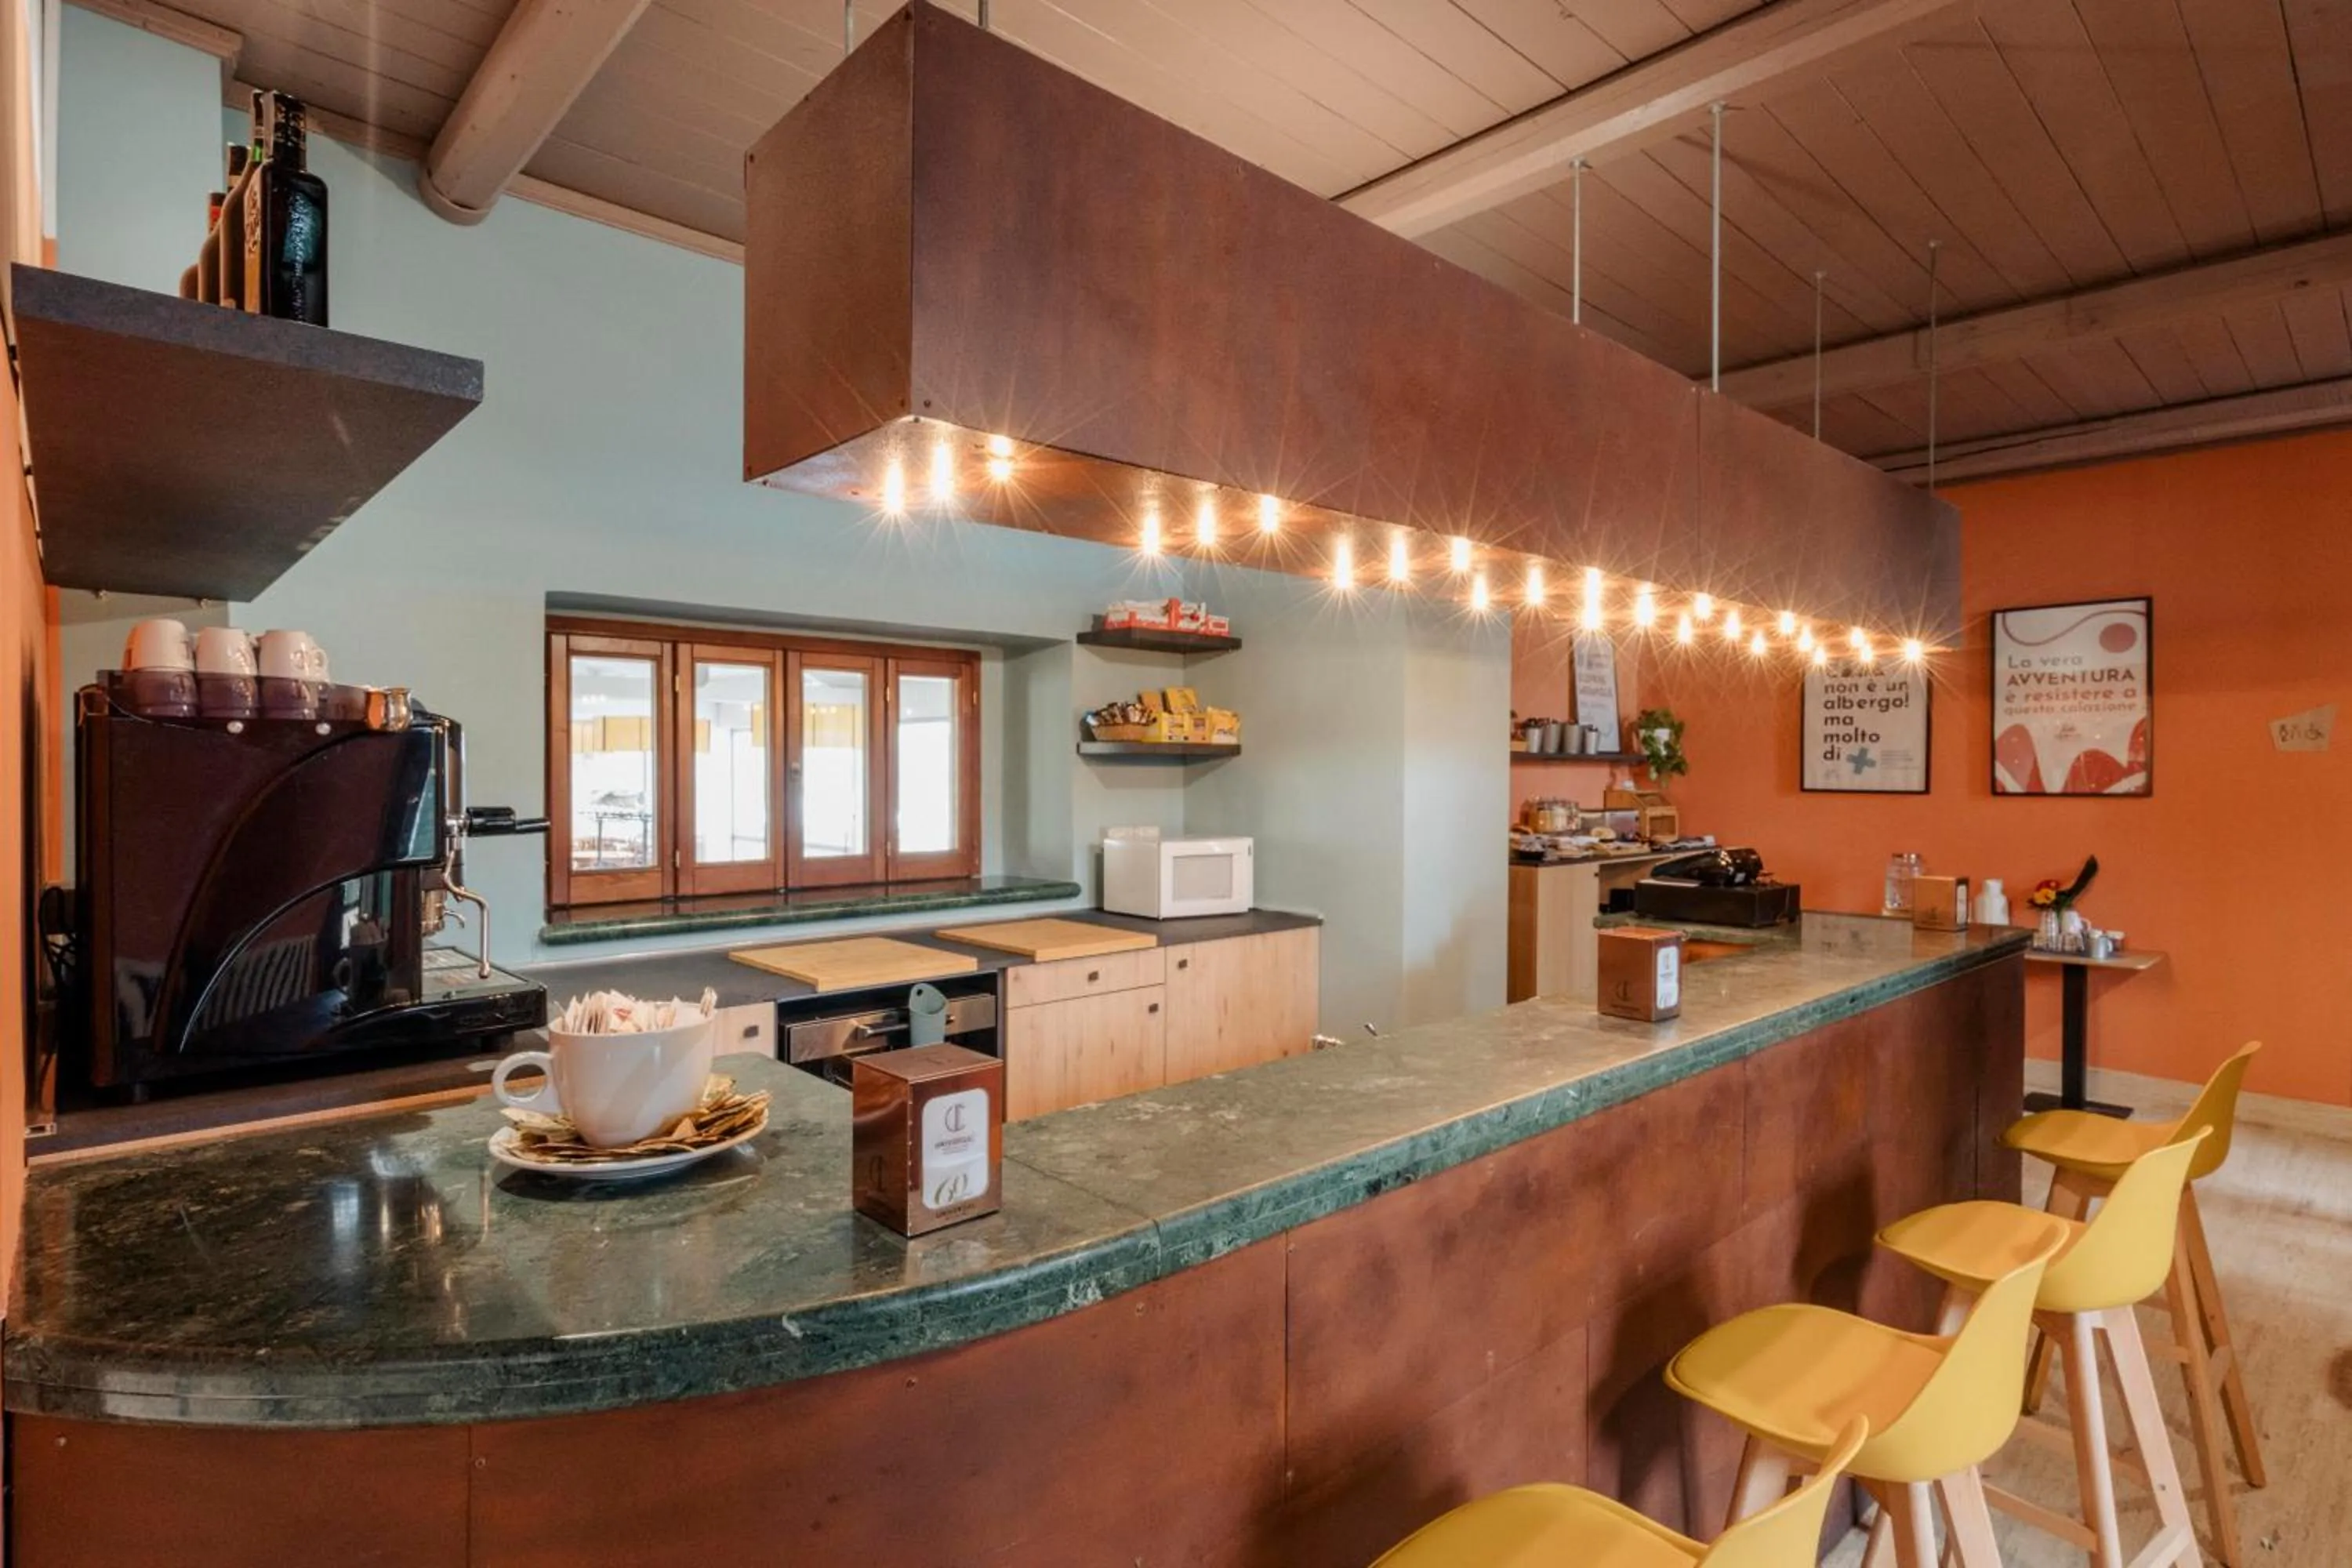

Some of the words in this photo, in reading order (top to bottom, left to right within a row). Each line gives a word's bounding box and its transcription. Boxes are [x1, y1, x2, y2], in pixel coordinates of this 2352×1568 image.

[2007, 654, 2032, 669] La
[2040, 655, 2082, 666] vera
[2007, 668, 2135, 687] AVVENTURA
[1824, 682, 1859, 693] non
[2024, 687, 2114, 702] resistere
[2123, 688, 2136, 699] a
[1824, 691, 1909, 713] albergo!
[1824, 715, 1854, 726] ma
[1824, 727, 1880, 743] molto
[1824, 745, 1841, 760] di
